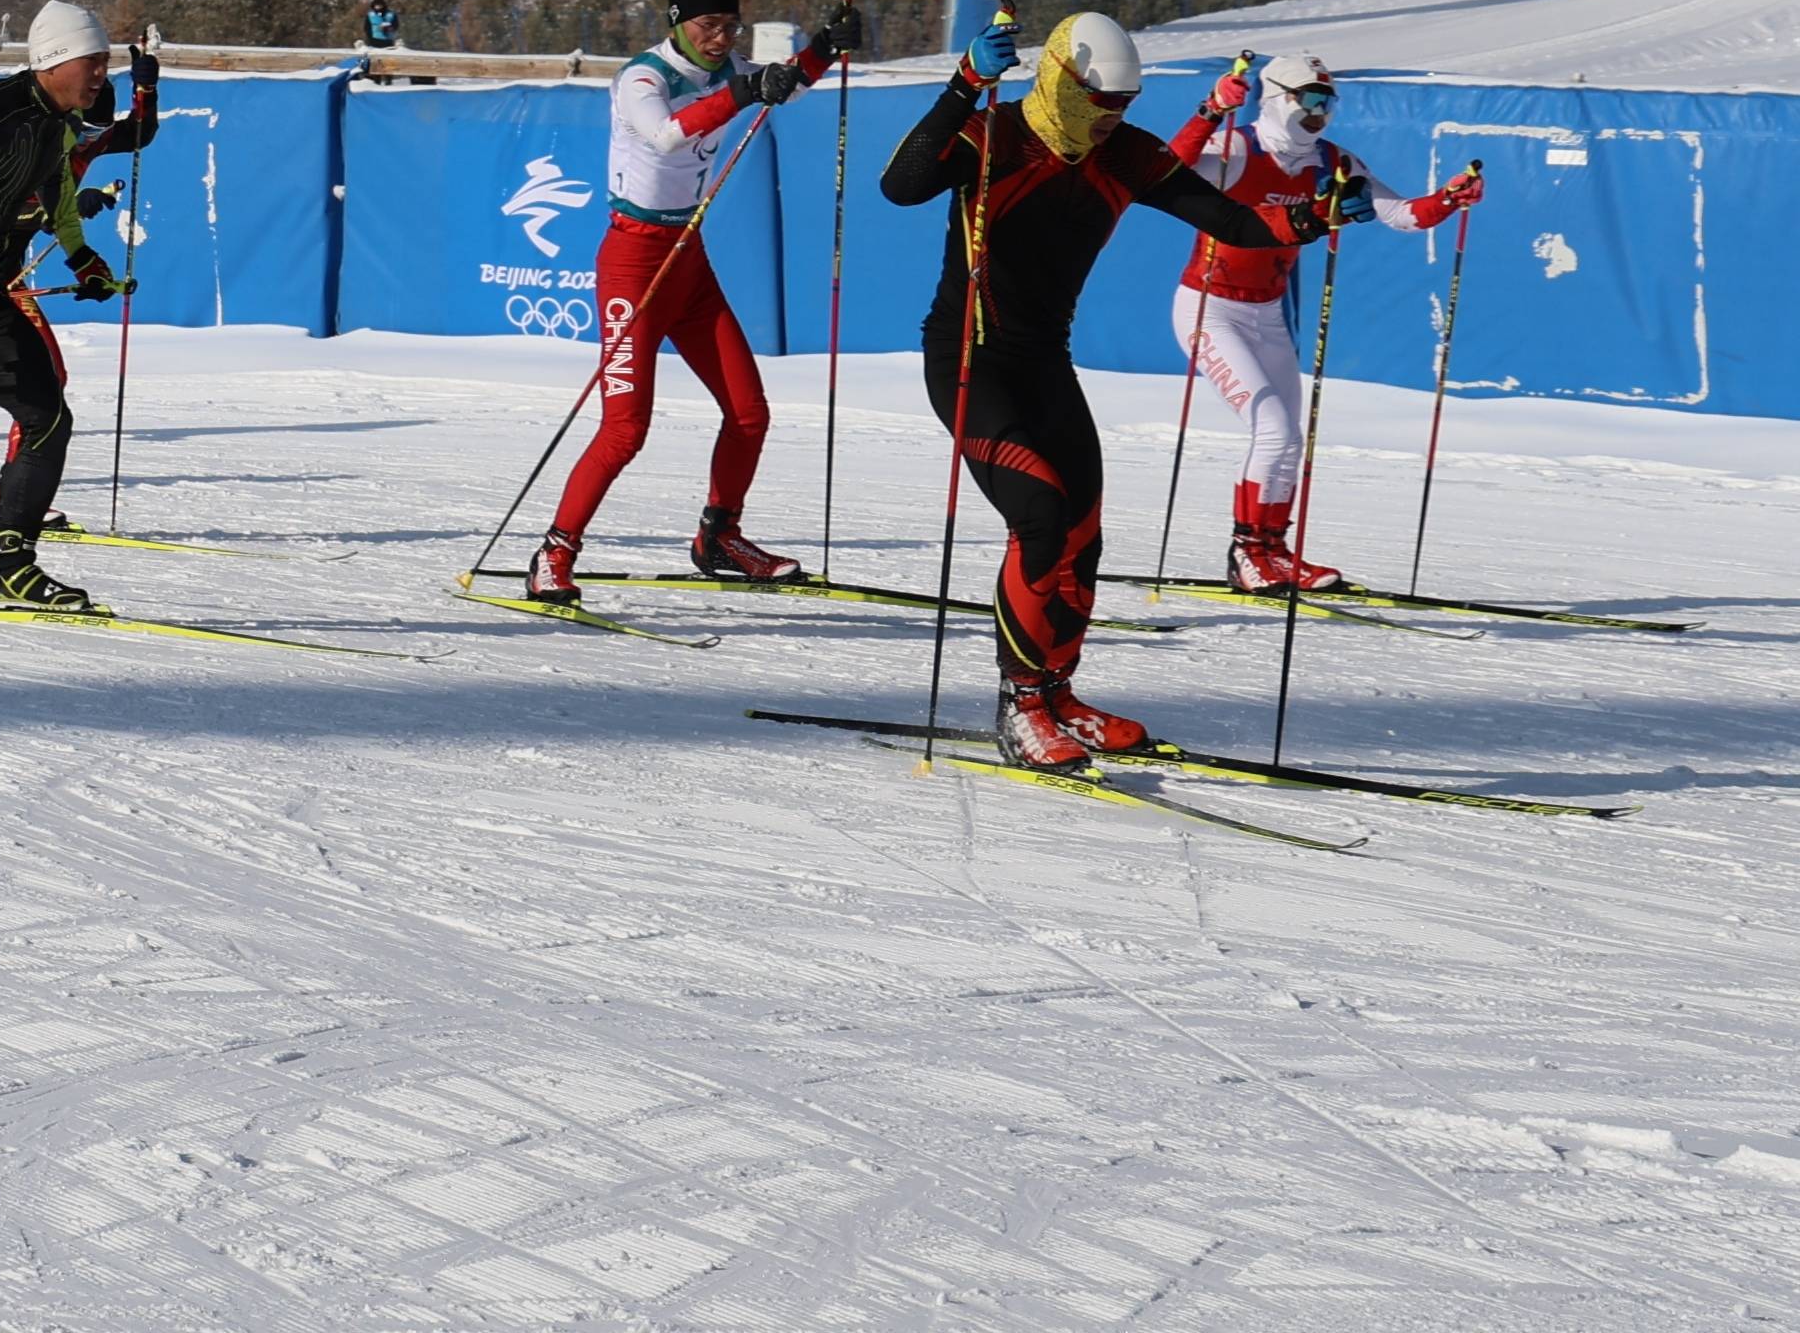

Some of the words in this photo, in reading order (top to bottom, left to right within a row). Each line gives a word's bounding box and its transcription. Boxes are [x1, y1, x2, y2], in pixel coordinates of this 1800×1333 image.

[479, 264, 553, 291] BEIJING
[557, 270, 598, 290] 202
[605, 297, 635, 398] CHINA
[1187, 331, 1251, 415] CHINA
[40, 532, 82, 542] CHER
[747, 584, 831, 598] FISCHER
[31, 613, 111, 628] FISCHER
[1035, 774, 1094, 795] FISCHER
[1418, 791, 1593, 815] FISCHER
